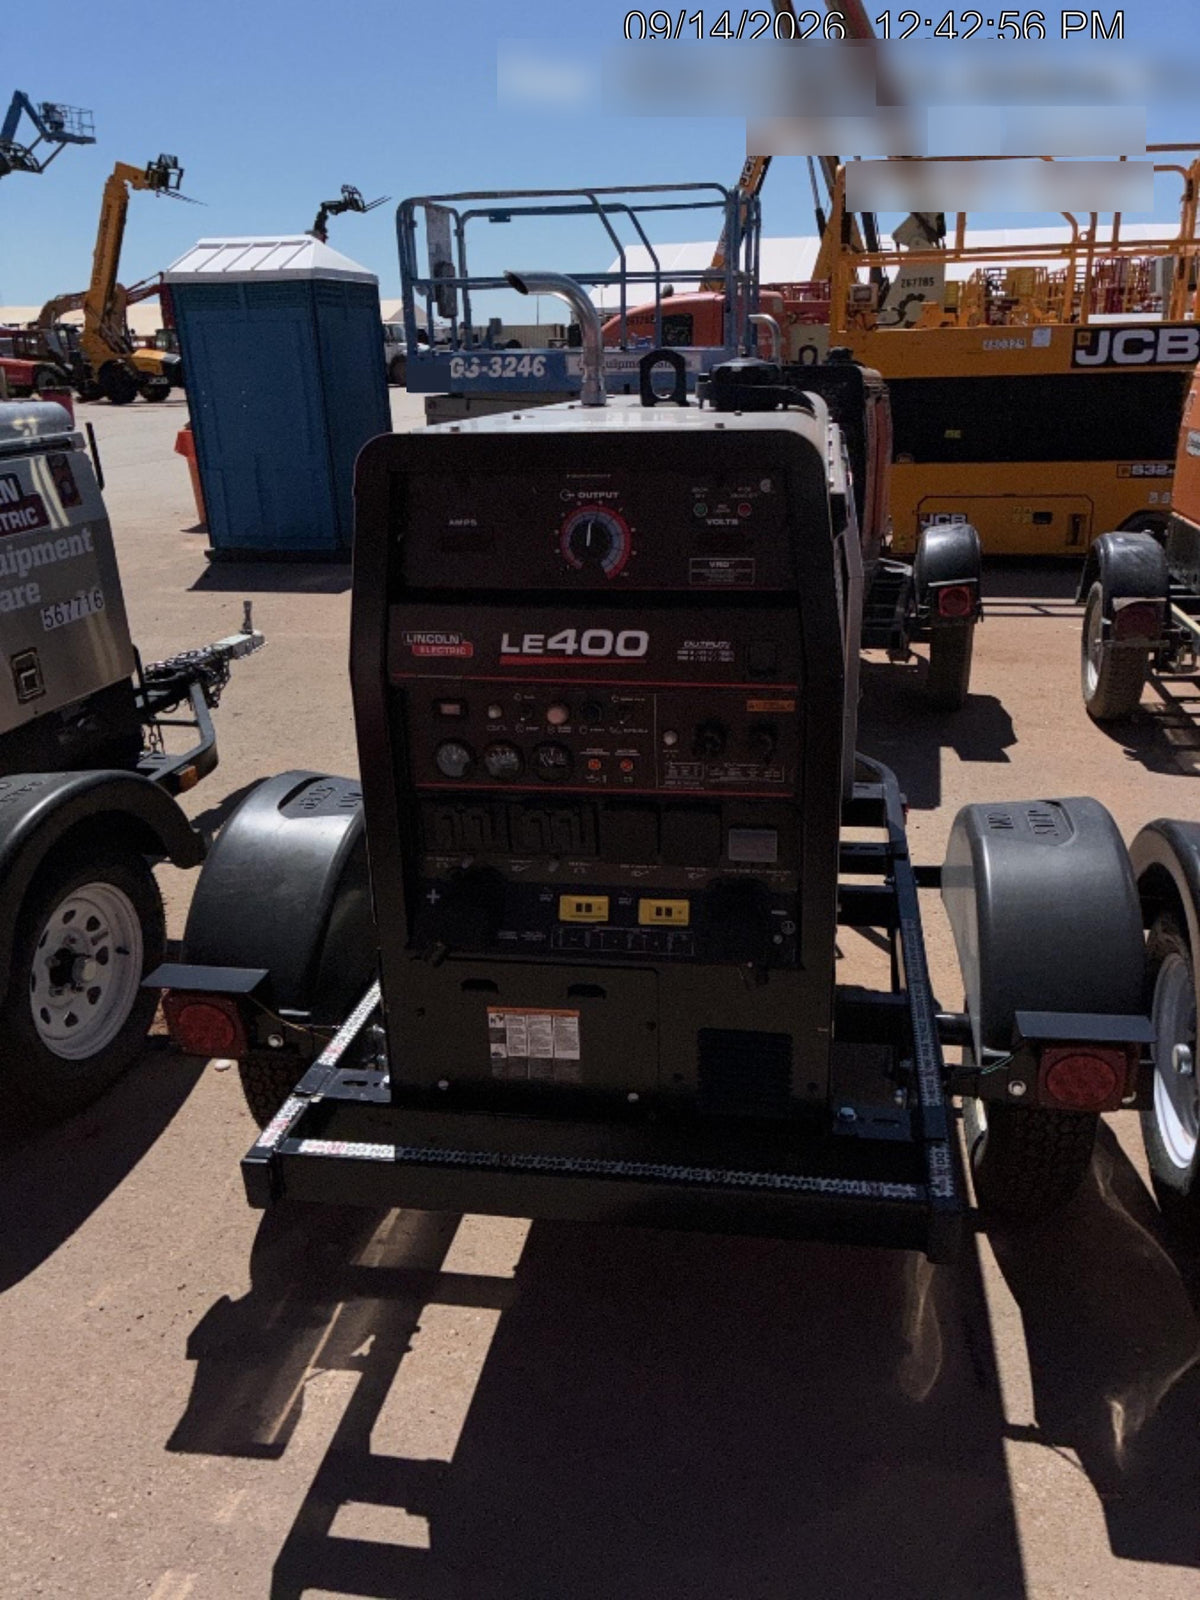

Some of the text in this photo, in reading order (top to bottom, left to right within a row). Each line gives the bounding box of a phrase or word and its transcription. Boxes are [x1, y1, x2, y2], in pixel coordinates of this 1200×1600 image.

[1075, 328, 1200, 365] JCB
[449, 355, 547, 378] GS-3246
[0, 478, 20, 504] N
[577, 491, 619, 499] OUTPUT
[0, 506, 39, 532] TRIC
[706, 518, 739, 526] VOLTS
[920, 513, 967, 525] JCB
[43, 589, 104, 628] 567716
[406, 633, 460, 645] LINCOLN
[419, 645, 467, 655] ELECTRIC
[500, 628, 649, 657] LE400
